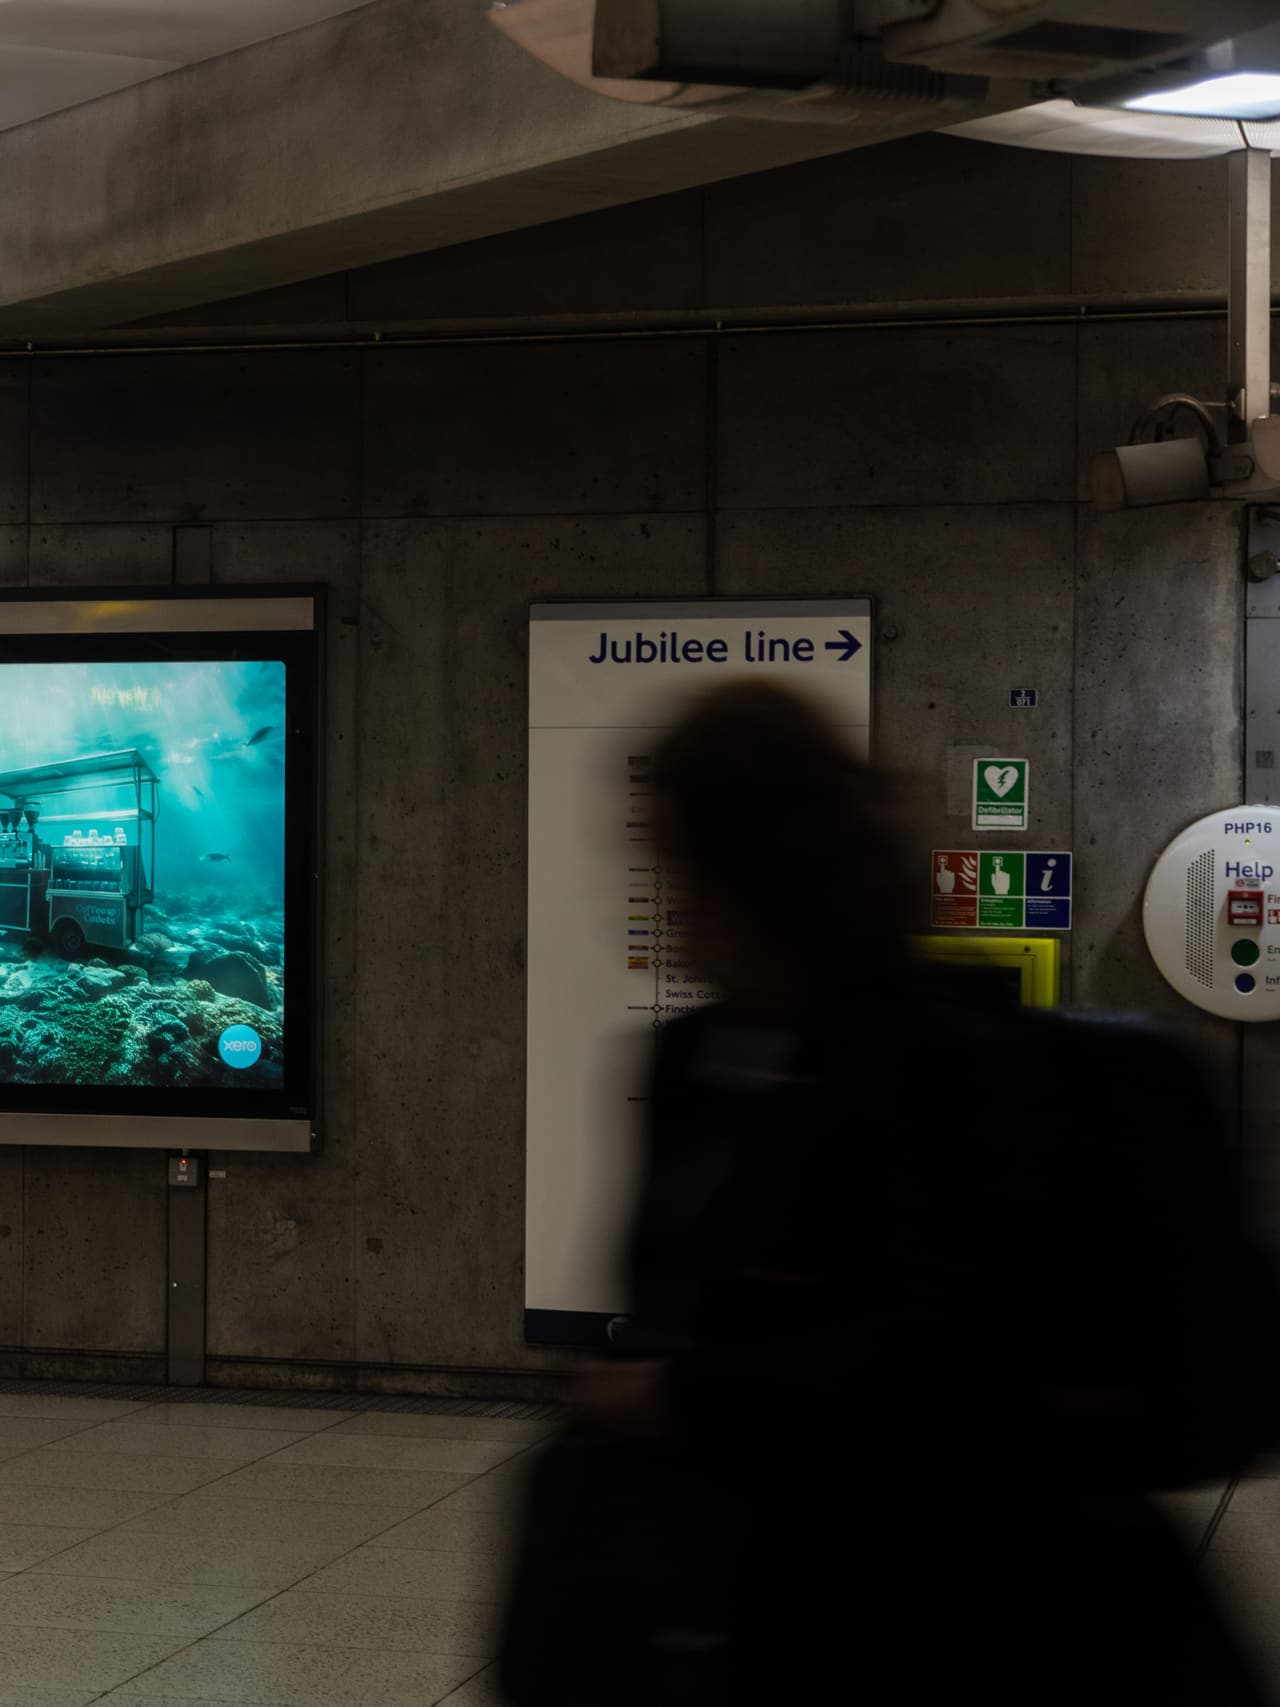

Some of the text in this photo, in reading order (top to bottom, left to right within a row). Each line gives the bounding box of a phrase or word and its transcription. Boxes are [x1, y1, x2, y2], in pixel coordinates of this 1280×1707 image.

[590, 631, 815, 664] Jubilee line
[978, 806, 1023, 815] Defibrillator
[1225, 823, 1272, 834] PHP16
[1225, 862, 1274, 882] Help
[75, 904, 106, 914] Coffee
[666, 975, 679, 983] St.
[666, 990, 693, 998] Swiss
[224, 1040, 257, 1052] xero
